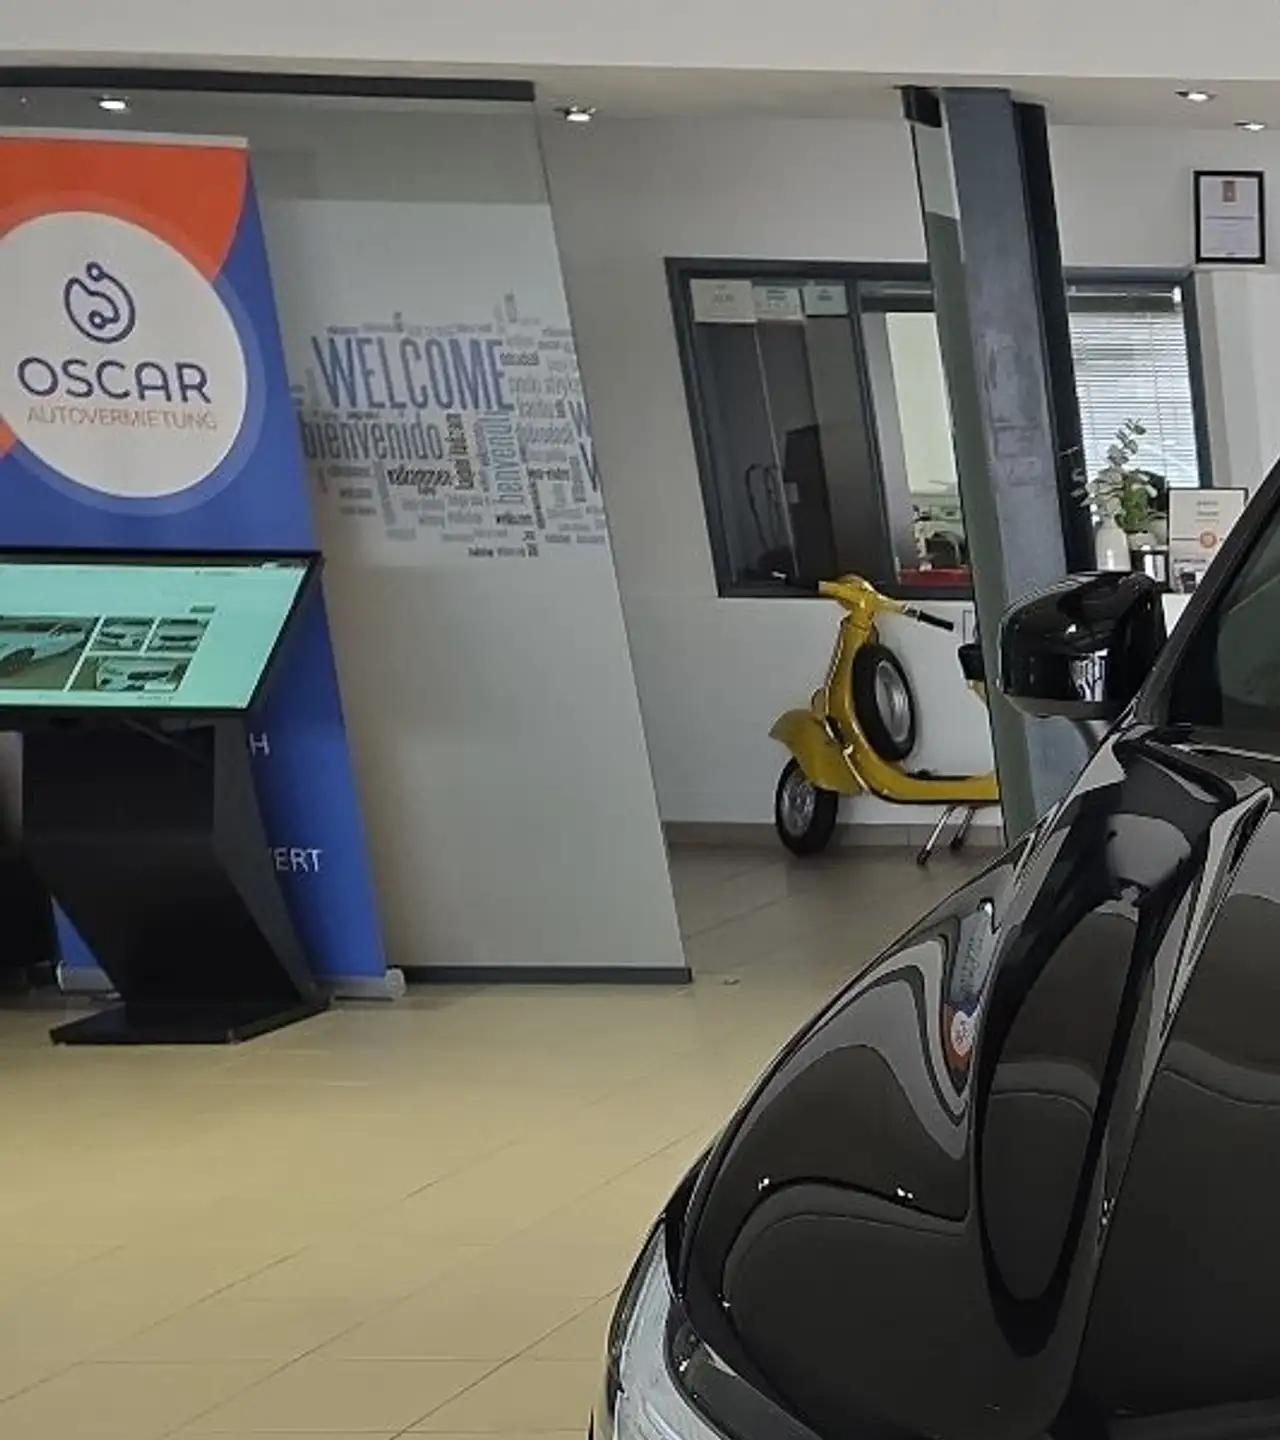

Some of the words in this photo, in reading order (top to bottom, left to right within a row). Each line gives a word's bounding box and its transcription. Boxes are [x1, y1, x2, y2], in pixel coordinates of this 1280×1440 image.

[16, 356, 213, 404] OSCAR
[310, 335, 515, 411] WELCOME
[26, 403, 218, 431] AUTOVERMIETUNG
[269, 847, 323, 873] ERT
